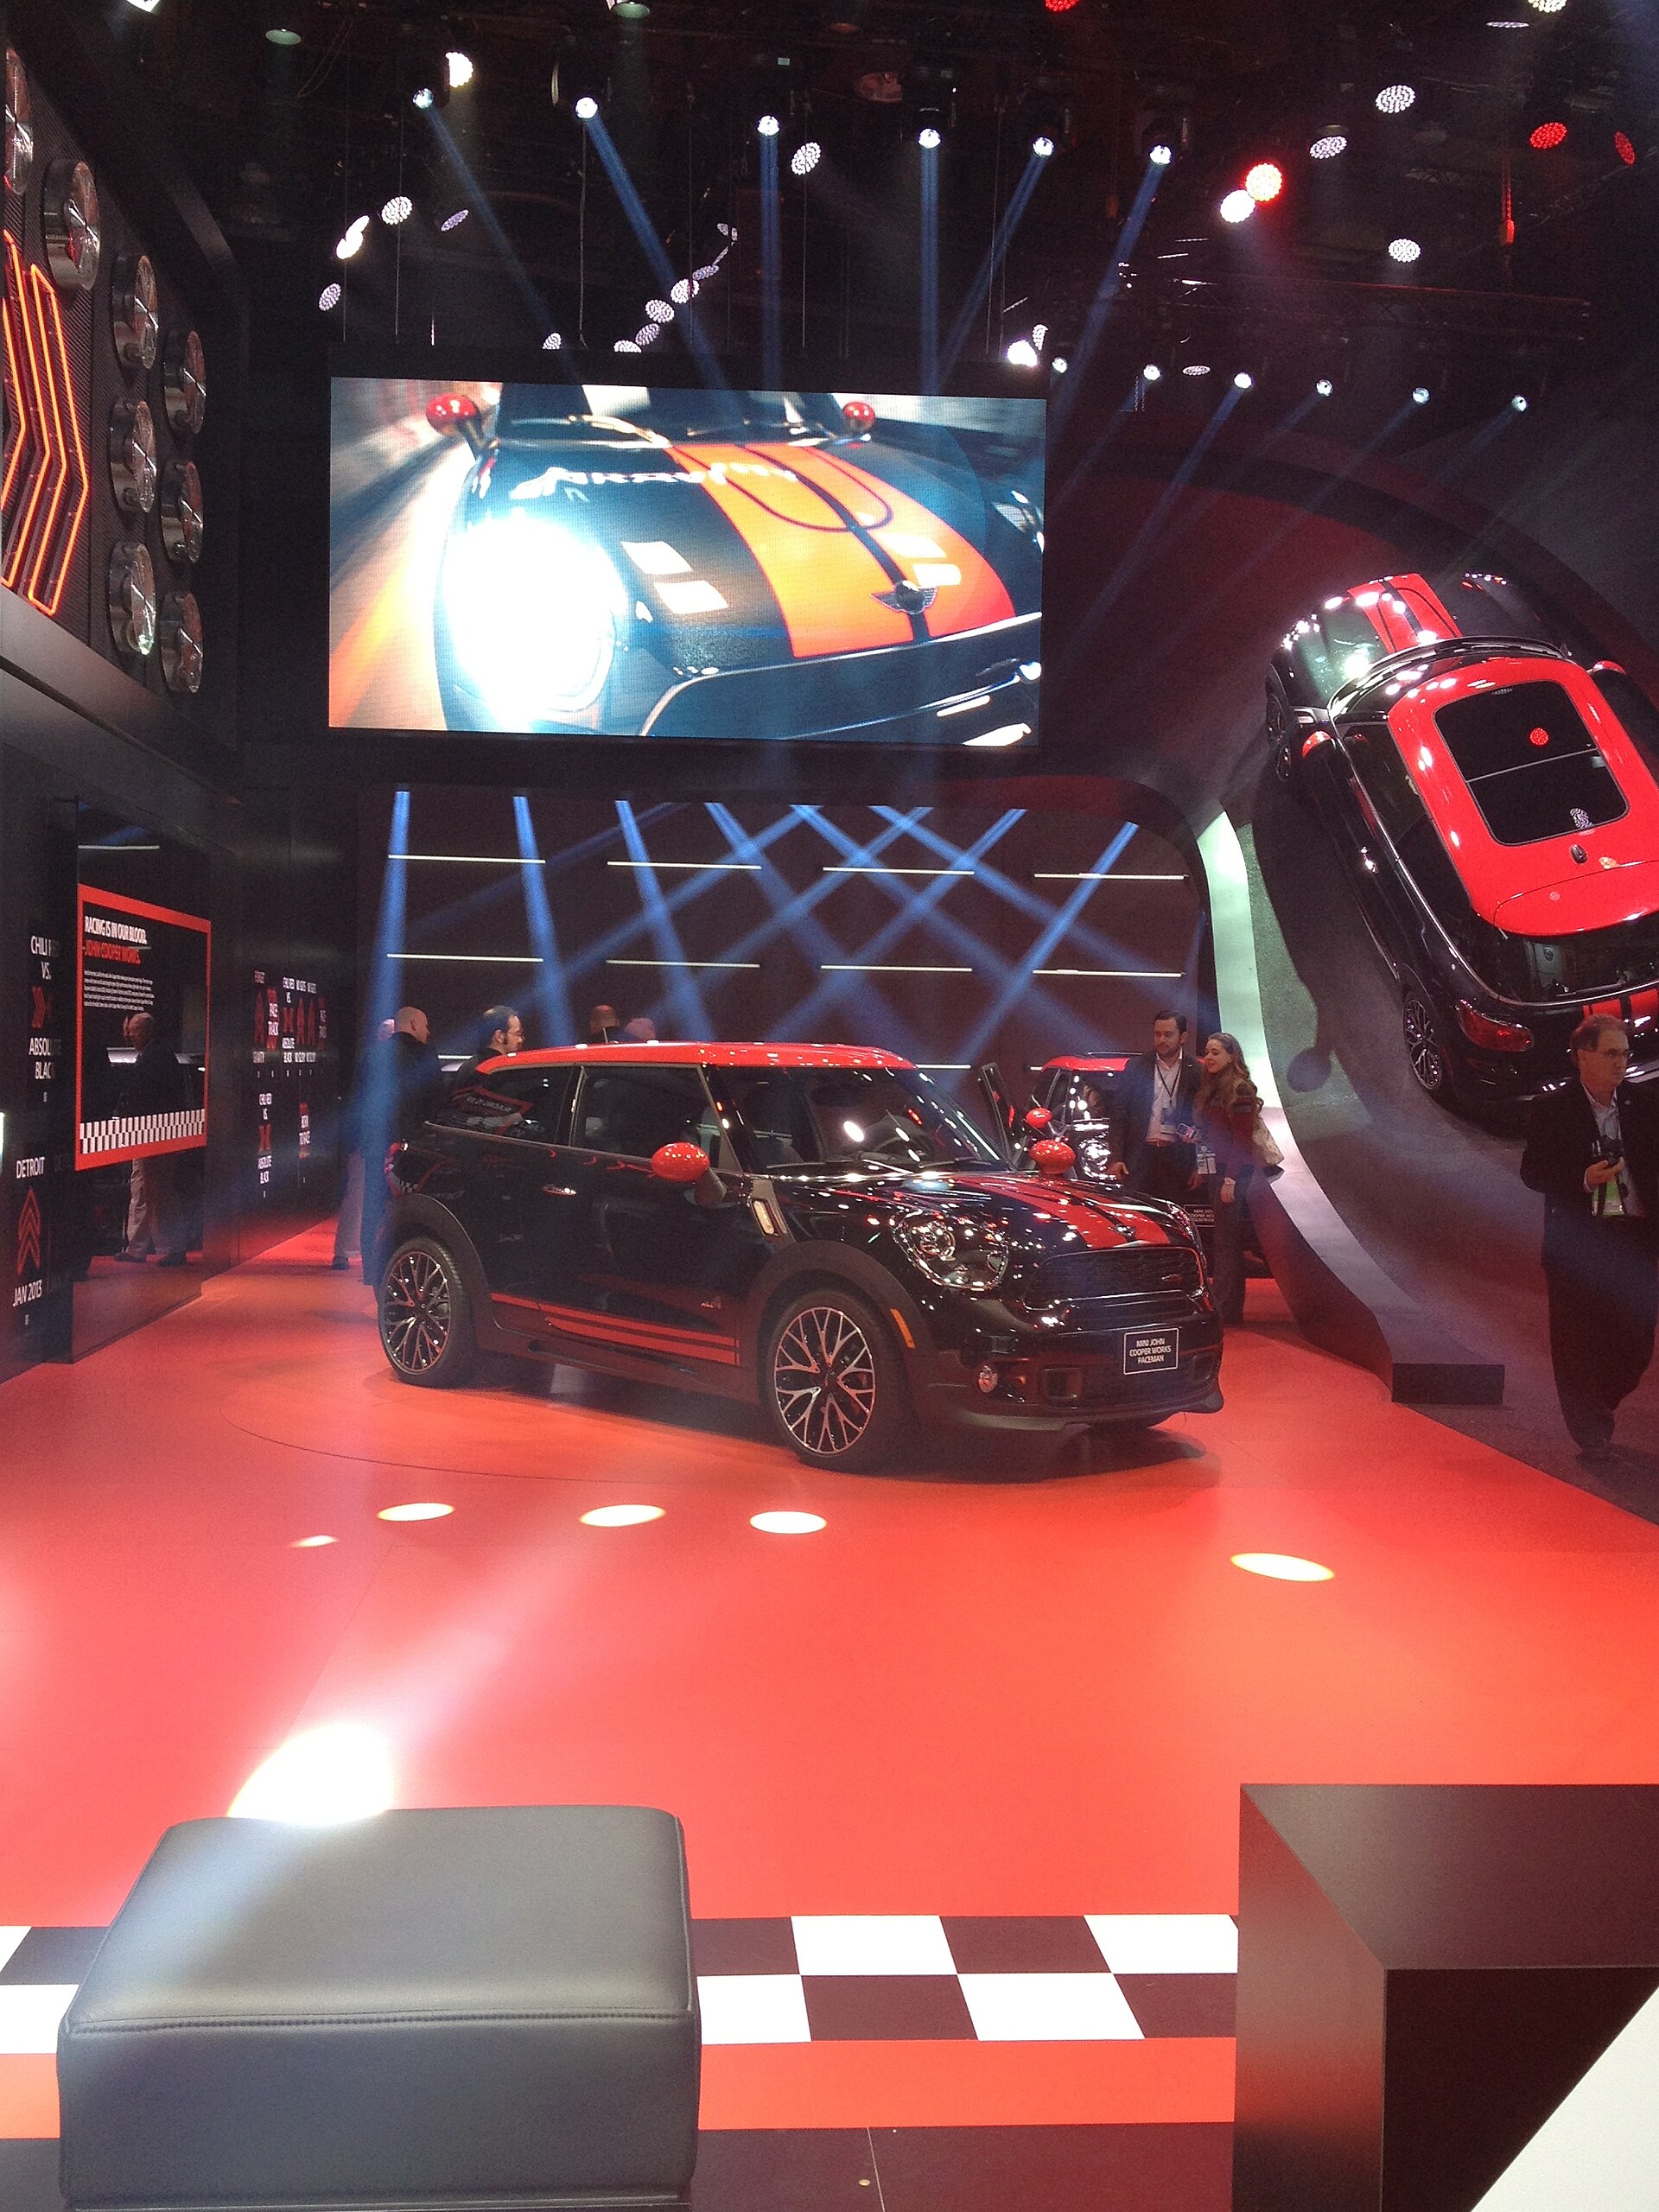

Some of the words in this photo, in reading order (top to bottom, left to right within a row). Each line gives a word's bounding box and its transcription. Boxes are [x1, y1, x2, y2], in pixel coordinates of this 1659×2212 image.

[85, 916, 105, 936] RACING
[105, 921, 111, 938] IS
[118, 924, 129, 941] OUR
[30, 935, 48, 956] CHILI
[41, 962, 51, 980] VS.
[16, 1156, 45, 1179] DETROIT
[13, 1284, 27, 1306] JAN
[28, 1279, 42, 1300] 2013
[1129, 1348, 1151, 1357] COOPER
[1152, 1345, 1172, 1354] WORKS
[1138, 1355, 1164, 1363] PACEMAN
